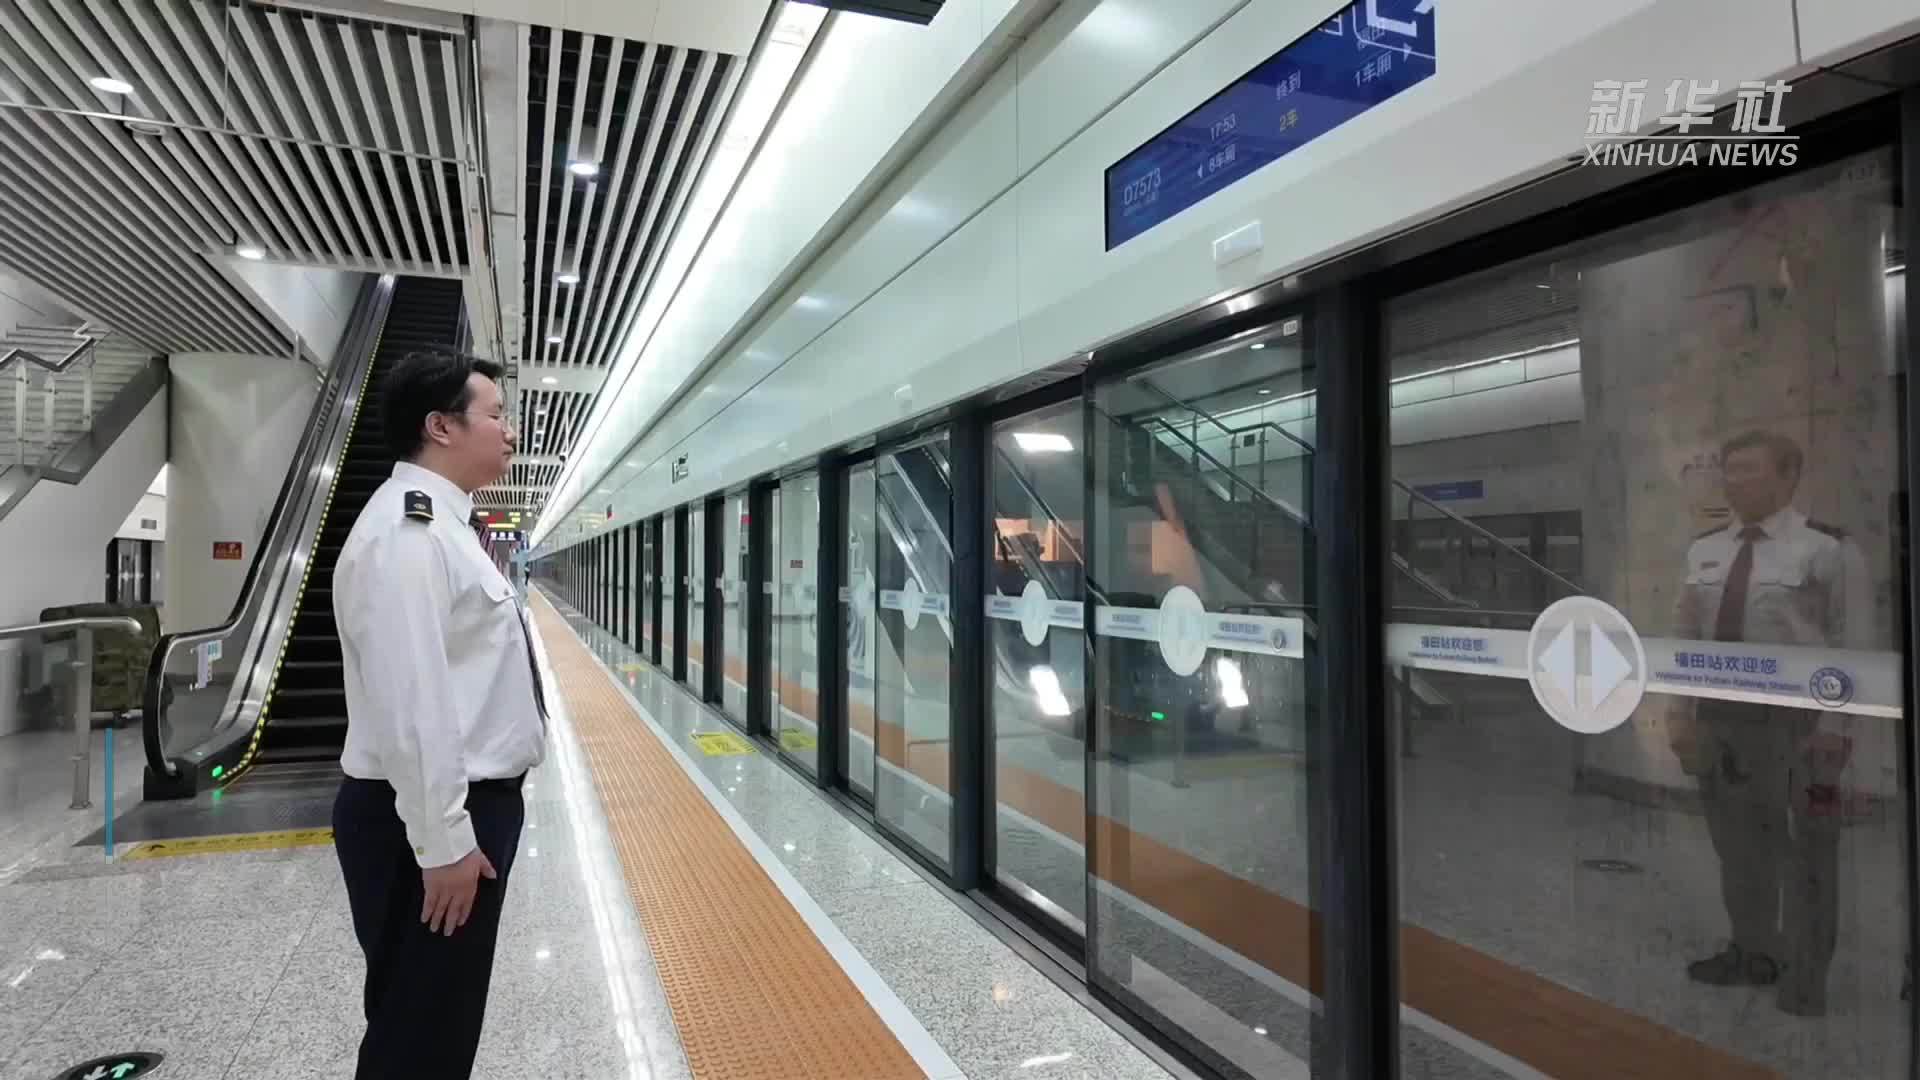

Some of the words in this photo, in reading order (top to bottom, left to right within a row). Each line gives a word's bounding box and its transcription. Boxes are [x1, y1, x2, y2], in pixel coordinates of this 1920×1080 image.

[1354, 51, 1392, 88] 1车厢
[1210, 113, 1236, 140] 17:53
[1675, 651, 1778, 674] 福田站欢迎您
